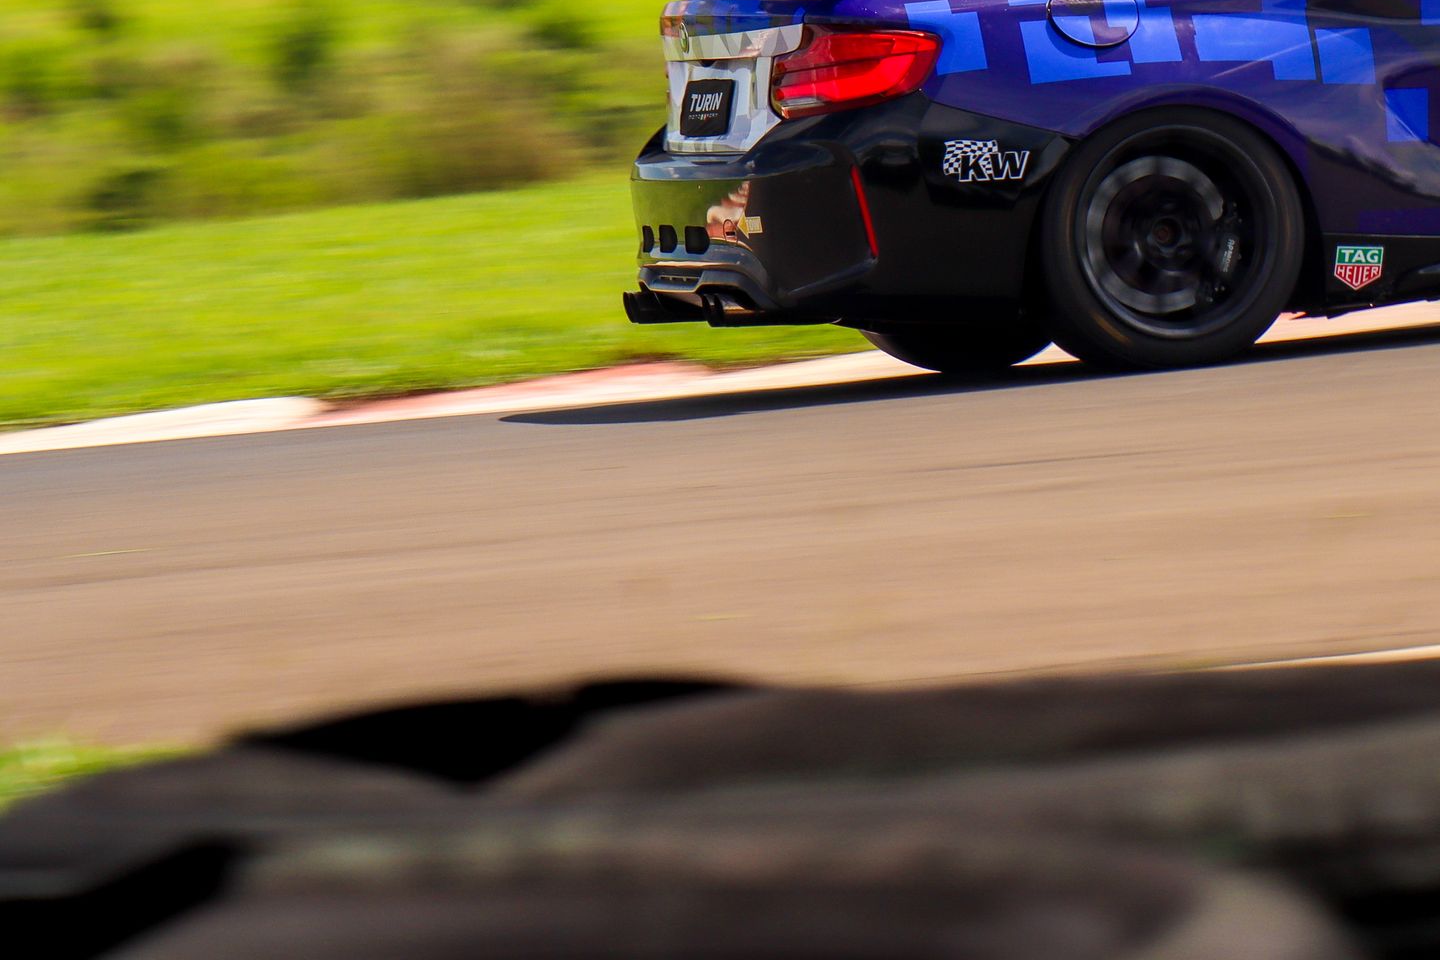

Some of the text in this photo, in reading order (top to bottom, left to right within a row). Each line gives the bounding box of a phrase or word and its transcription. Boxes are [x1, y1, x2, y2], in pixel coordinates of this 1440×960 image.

[690, 92, 723, 112] TURIN
[958, 151, 1030, 182] KW
[1341, 249, 1379, 263] TAG
[1337, 266, 1379, 286] HEUER
